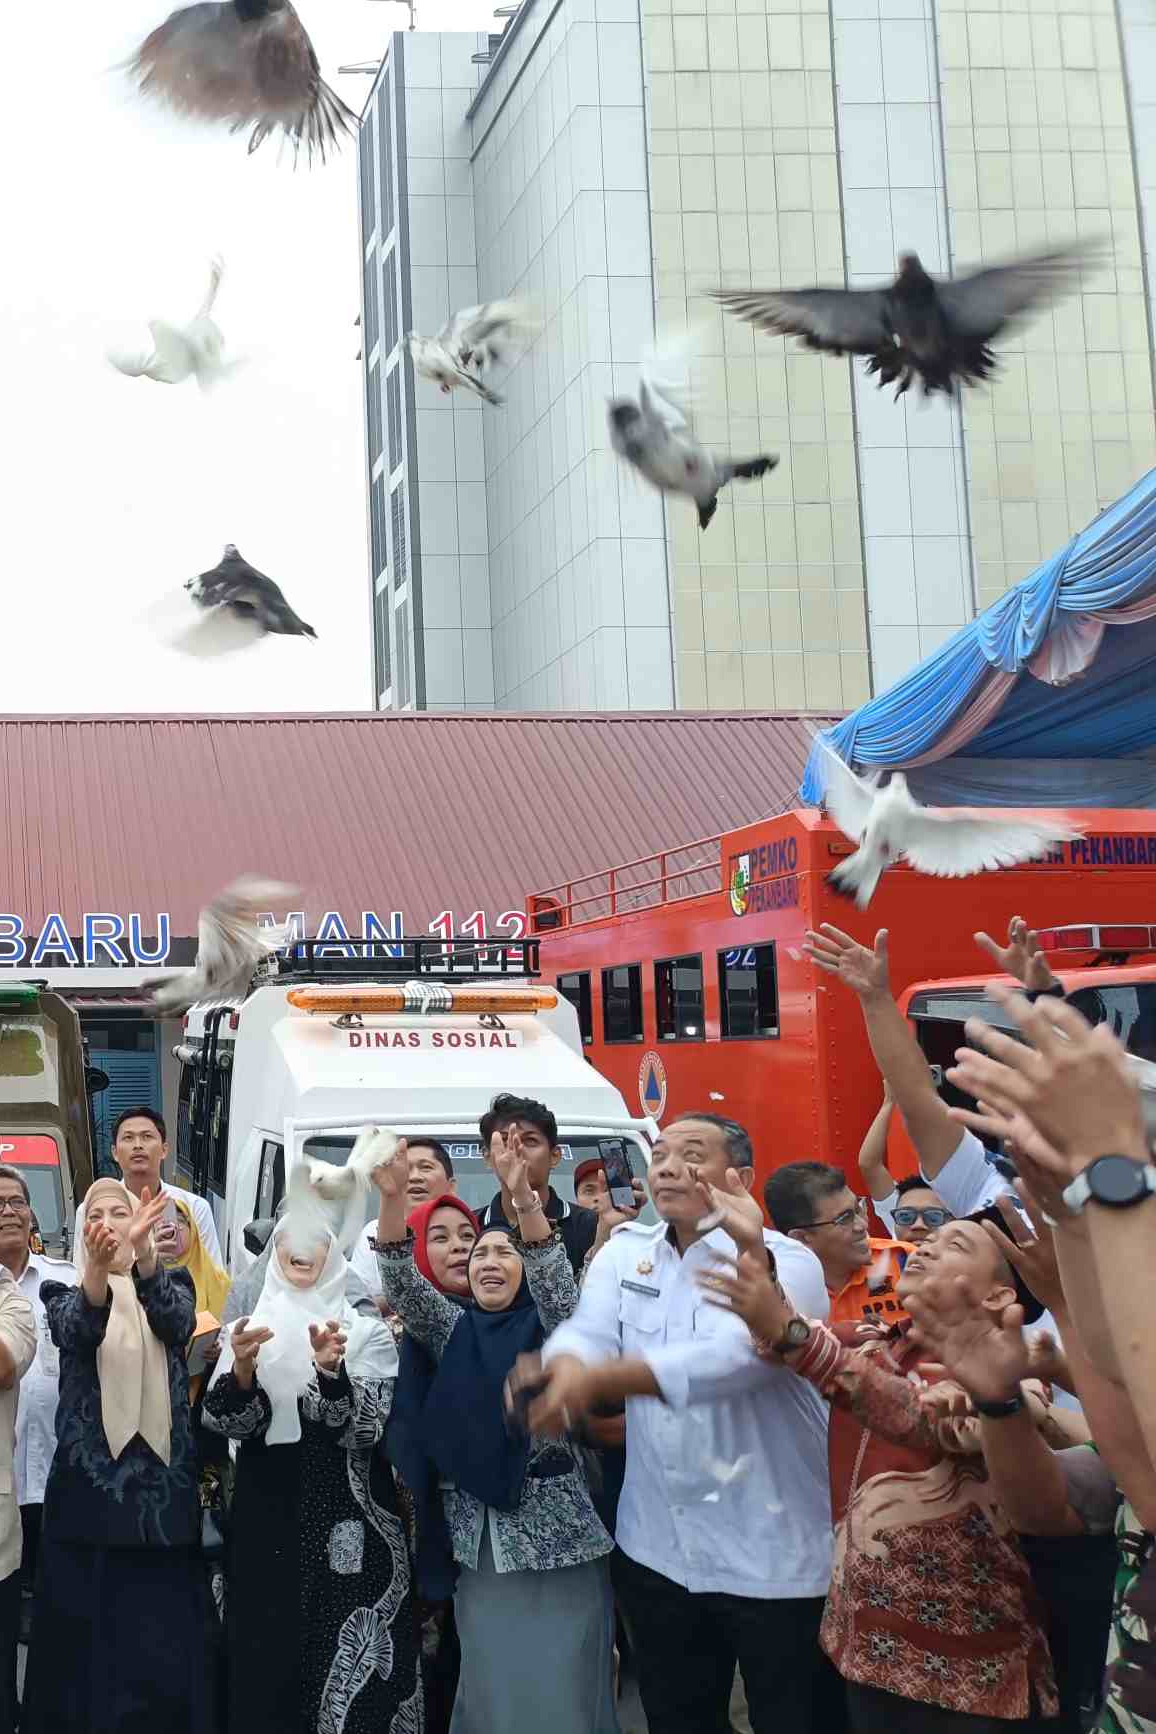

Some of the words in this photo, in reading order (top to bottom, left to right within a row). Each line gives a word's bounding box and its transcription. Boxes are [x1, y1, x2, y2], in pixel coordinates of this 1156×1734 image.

[1070, 837, 1156, 864] PEKANBAR
[256, 911, 404, 959] MAN
[428, 910, 527, 961] 112
[349, 1032, 421, 1048] DINAS
[432, 1032, 517, 1048] SOSIAL
